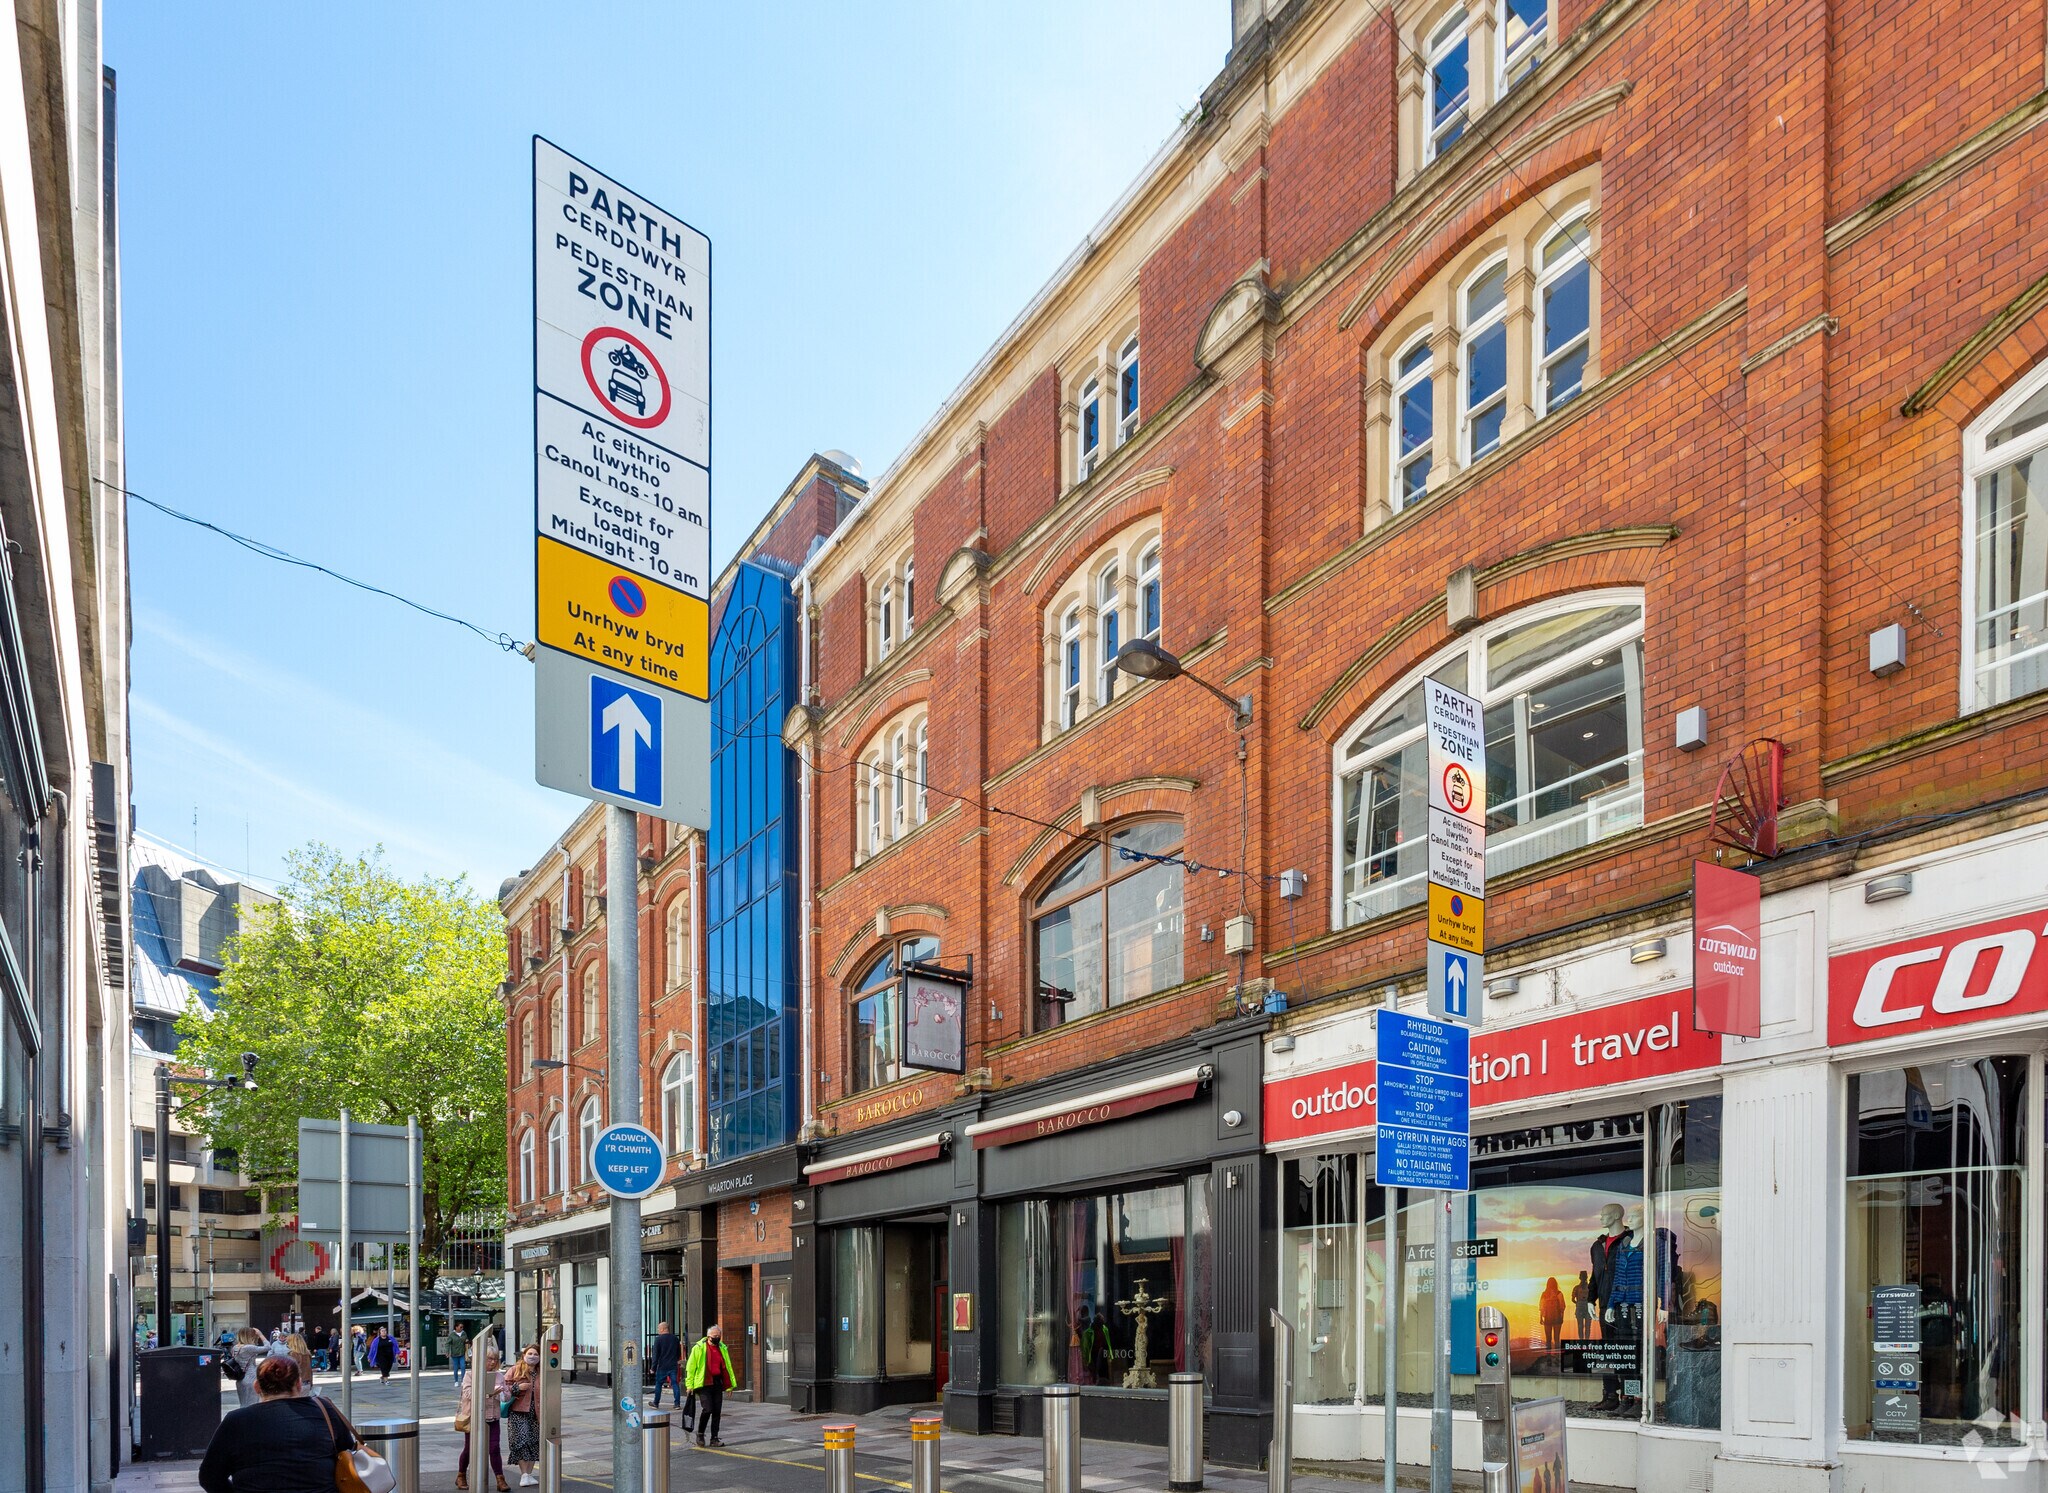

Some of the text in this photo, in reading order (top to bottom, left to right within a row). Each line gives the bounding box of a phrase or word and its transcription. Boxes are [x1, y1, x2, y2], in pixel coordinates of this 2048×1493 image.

[569, 171, 681, 259] PARTH
[563, 204, 686, 286] CERDDWYR
[556, 232, 692, 321] PEDESTRIAN
[578, 267, 672, 340] ZONE
[582, 422, 670, 473] Ac eithrio
[593, 446, 660, 488] llwytho
[546, 444, 600, 481] Canol
[609, 475, 639, 498] nos
[654, 493, 673, 512] 10
[678, 507, 702, 526] am
[580, 486, 673, 539] Except for
[594, 512, 659, 555] loading
[552, 514, 634, 562] Midnight
[650, 556, 668, 575] 10
[674, 571, 698, 588] am
[568, 601, 684, 658] Unrhyw bryd
[574, 631, 678, 681] At any time
[1435, 689, 1474, 718] PARTH
[1434, 705, 1476, 731] CERDDWYR
[1433, 721, 1479, 749] PEDESTRIAN
[1441, 736, 1473, 761] ZONE
[1443, 817, 1472, 834] Ac eithrio
[1446, 828, 1468, 843] llwytho
[1431, 834, 1449, 847] Canol
[1451, 843, 1461, 851] nos
[1466, 847, 1473, 855] 10
[1442, 852, 1472, 869] Except for
[1433, 870, 1459, 886] Midnight
[1464, 882, 1471, 890] 10
[1446, 864, 1468, 880] loading
[1438, 914, 1476, 934] Unrhyw bryd
[1440, 930, 1473, 947] At any time
[1699, 938, 1757, 960] COTSWOLD
[1714, 962, 1744, 976] outdoor
[1853, 922, 2048, 1028] CO
[1408, 1020, 1442, 1035] RHYBUDD
[1572, 1011, 1678, 1066] travel
[911, 1049, 957, 1061] BAROCCO
[1402, 1052, 1447, 1064] AUTOMATIC BOLLARDS
[1409, 1042, 1440, 1056] CAUTION
[1416, 1061, 1439, 1069] OPERATION
[1416, 1075, 1434, 1085] STOP
[858, 1089, 923, 1123] BAROCCO
[1416, 1102, 1434, 1112] STOP
[1038, 1105, 1110, 1134] BAROCCO
[610, 1134, 646, 1143] CADWCH
[1380, 1129, 1466, 1147] DIM GYRRU'N RHY AGOS
[618, 1146, 651, 1154] CHWITH
[609, 1165, 648, 1174] KEEP LEFT
[846, 1156, 892, 1177] BAROCCO
[1397, 1159, 1451, 1172] NO TAILGATING
[1413, 1170, 1429, 1178] COMPLY
[708, 1174, 753, 1194] WHARTON PLACE
[754, 1220, 766, 1242] 13
[1408, 1247, 1416, 1259] A
[1456, 1242, 1494, 1256] start:
[1453, 1281, 1488, 1292] route
[1609, 1362, 1636, 1370] experts
